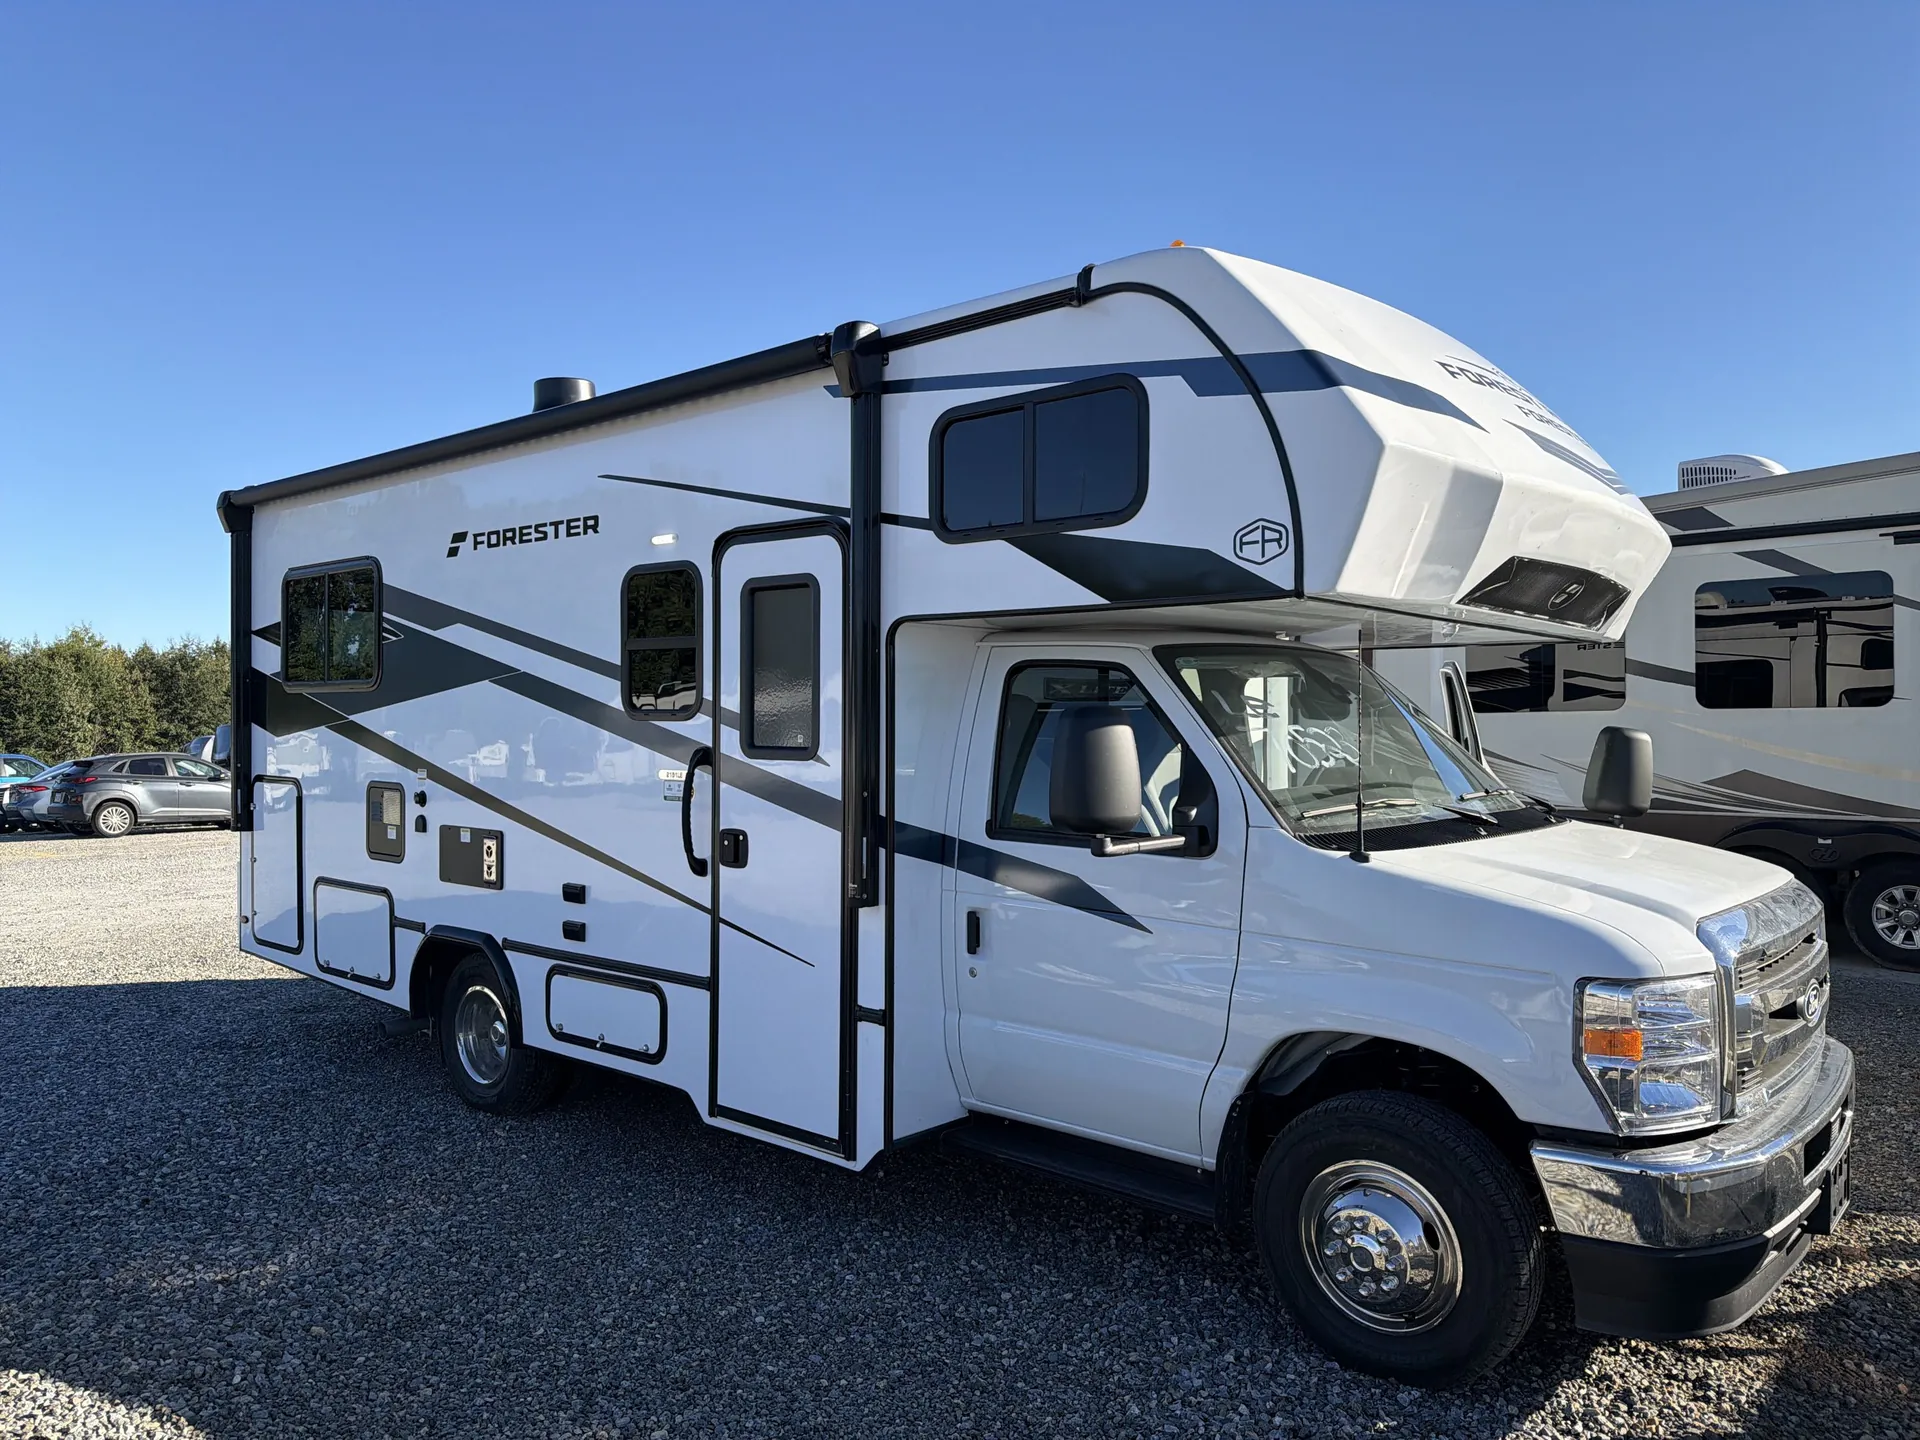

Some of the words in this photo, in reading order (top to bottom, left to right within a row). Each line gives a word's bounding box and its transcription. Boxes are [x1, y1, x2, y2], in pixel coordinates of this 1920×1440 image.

[472, 514, 600, 551] FORESTER
[1238, 523, 1284, 560] FR
[1079, 684, 1128, 695] LIE
